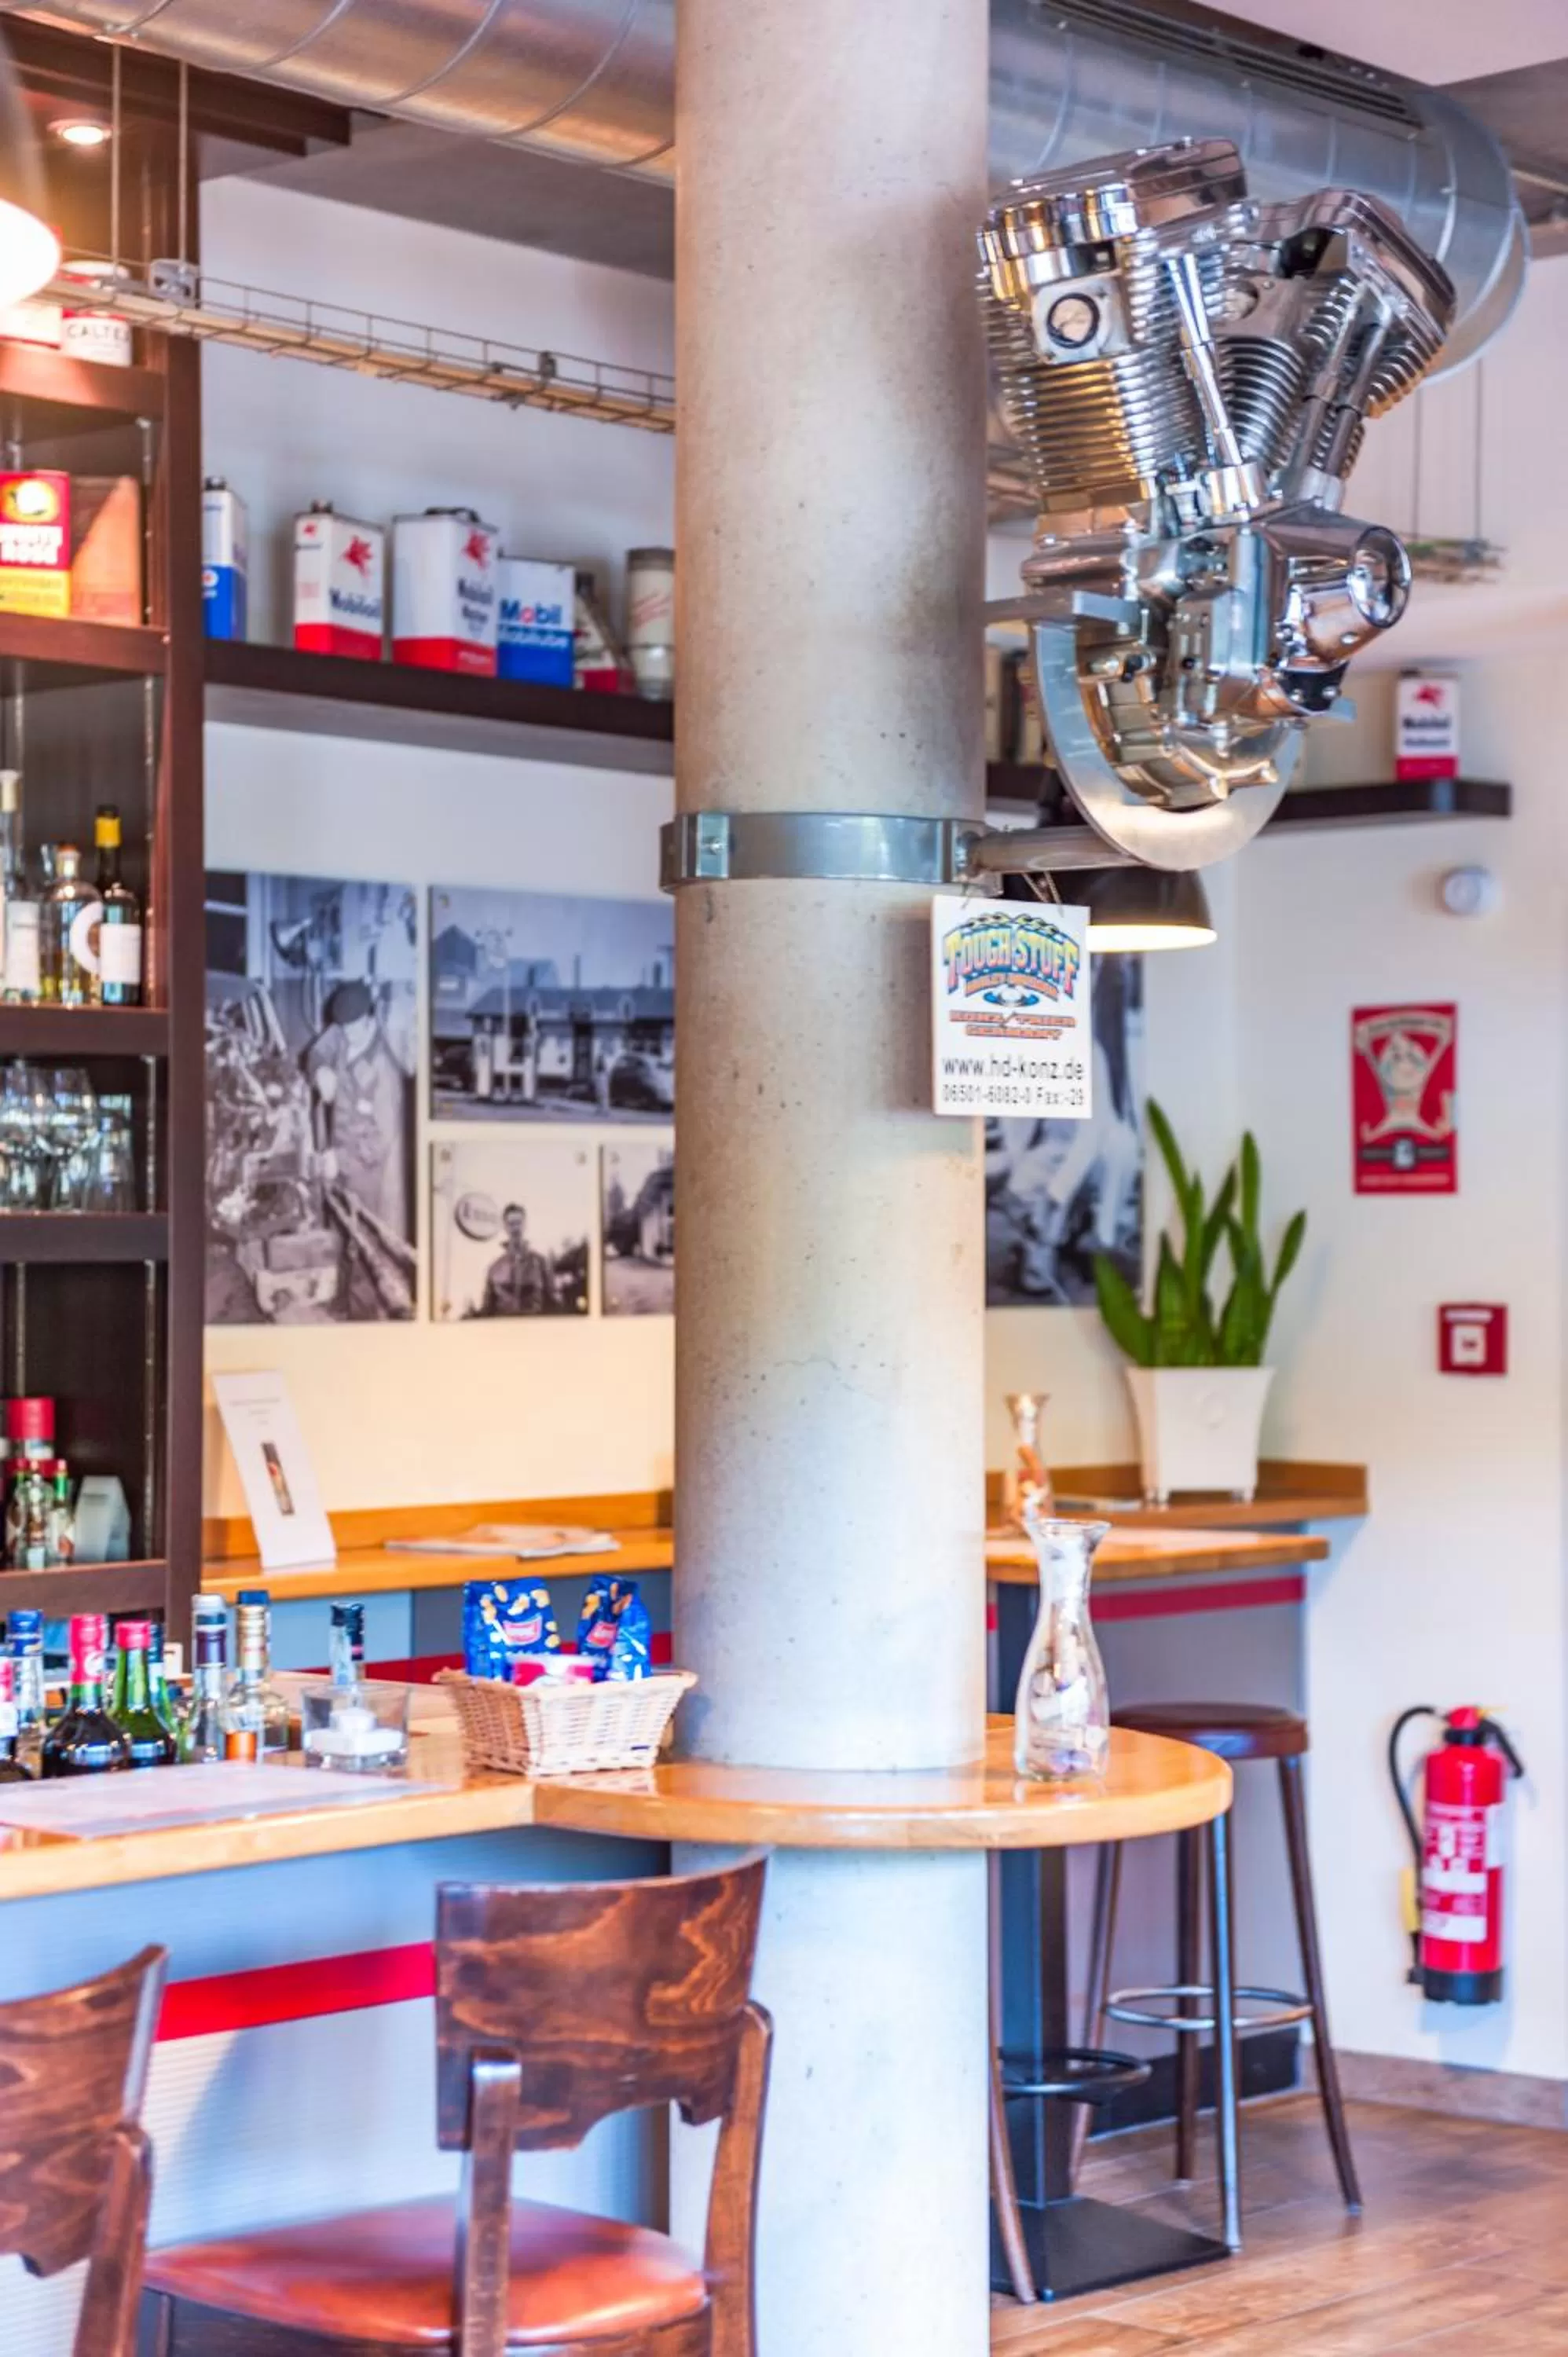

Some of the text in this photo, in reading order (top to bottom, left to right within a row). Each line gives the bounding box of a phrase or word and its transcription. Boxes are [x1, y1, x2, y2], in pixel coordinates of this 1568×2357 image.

[498, 598, 562, 624] Mobil
[1013, 927, 1080, 999] STUFF
[942, 1054, 1084, 1080] www.hd-konz.de
[1035, 1087, 1062, 1105] Fax
